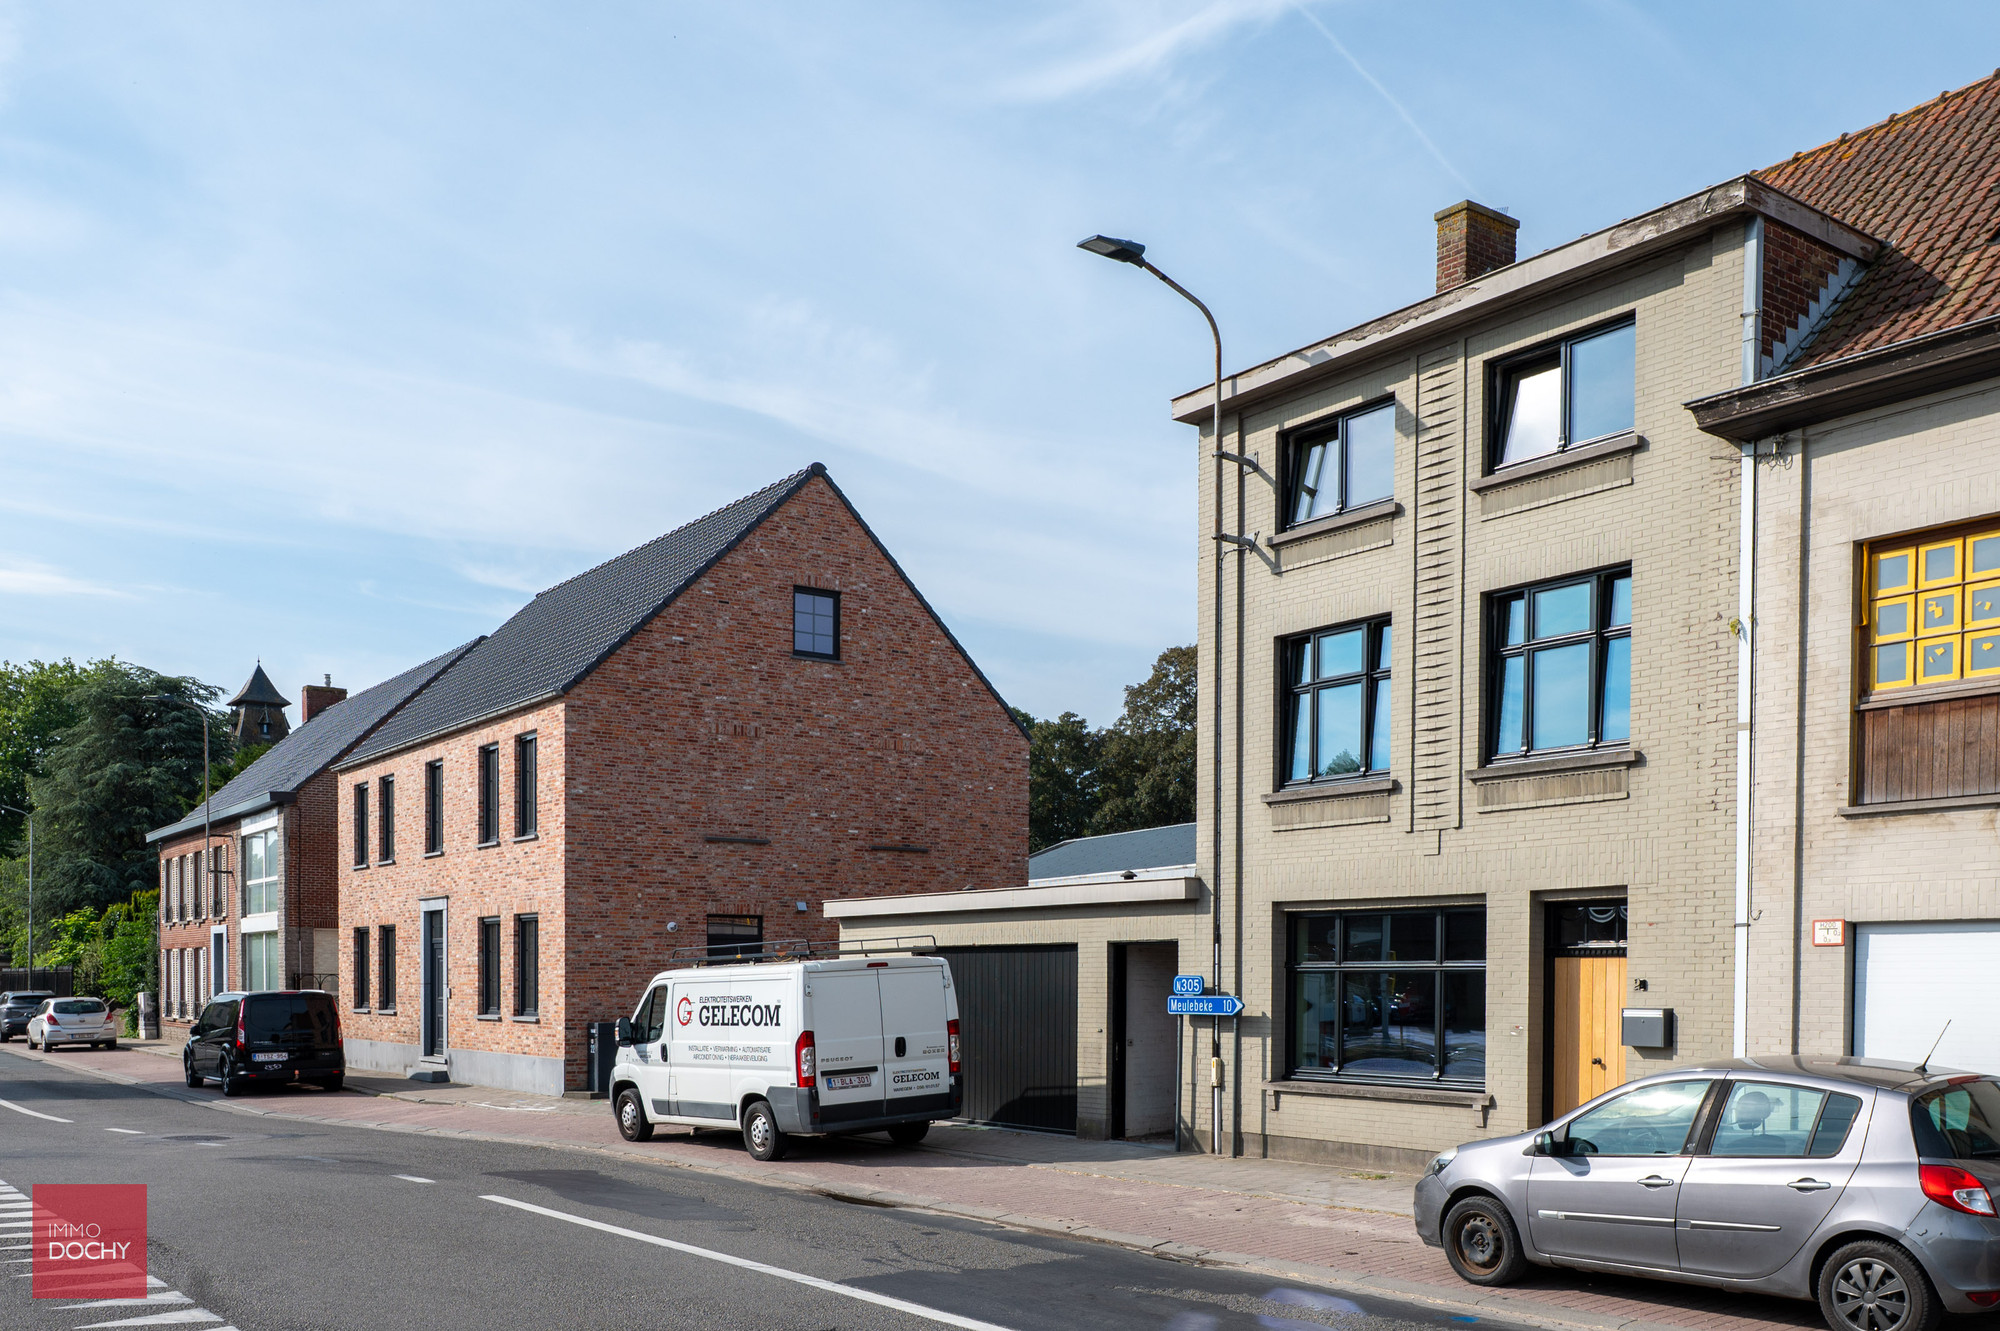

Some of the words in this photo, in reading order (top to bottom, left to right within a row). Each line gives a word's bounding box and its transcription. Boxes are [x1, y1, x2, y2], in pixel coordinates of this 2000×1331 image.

[1176, 979, 1200, 992] N305
[699, 995, 753, 1004] ELEKTRICITEITSWERKEN
[1170, 999, 1213, 1012] Meulebeke
[1223, 999, 1233, 1012] 10
[699, 1005, 782, 1027] GELECOM
[892, 1071, 940, 1084] GELECOM
